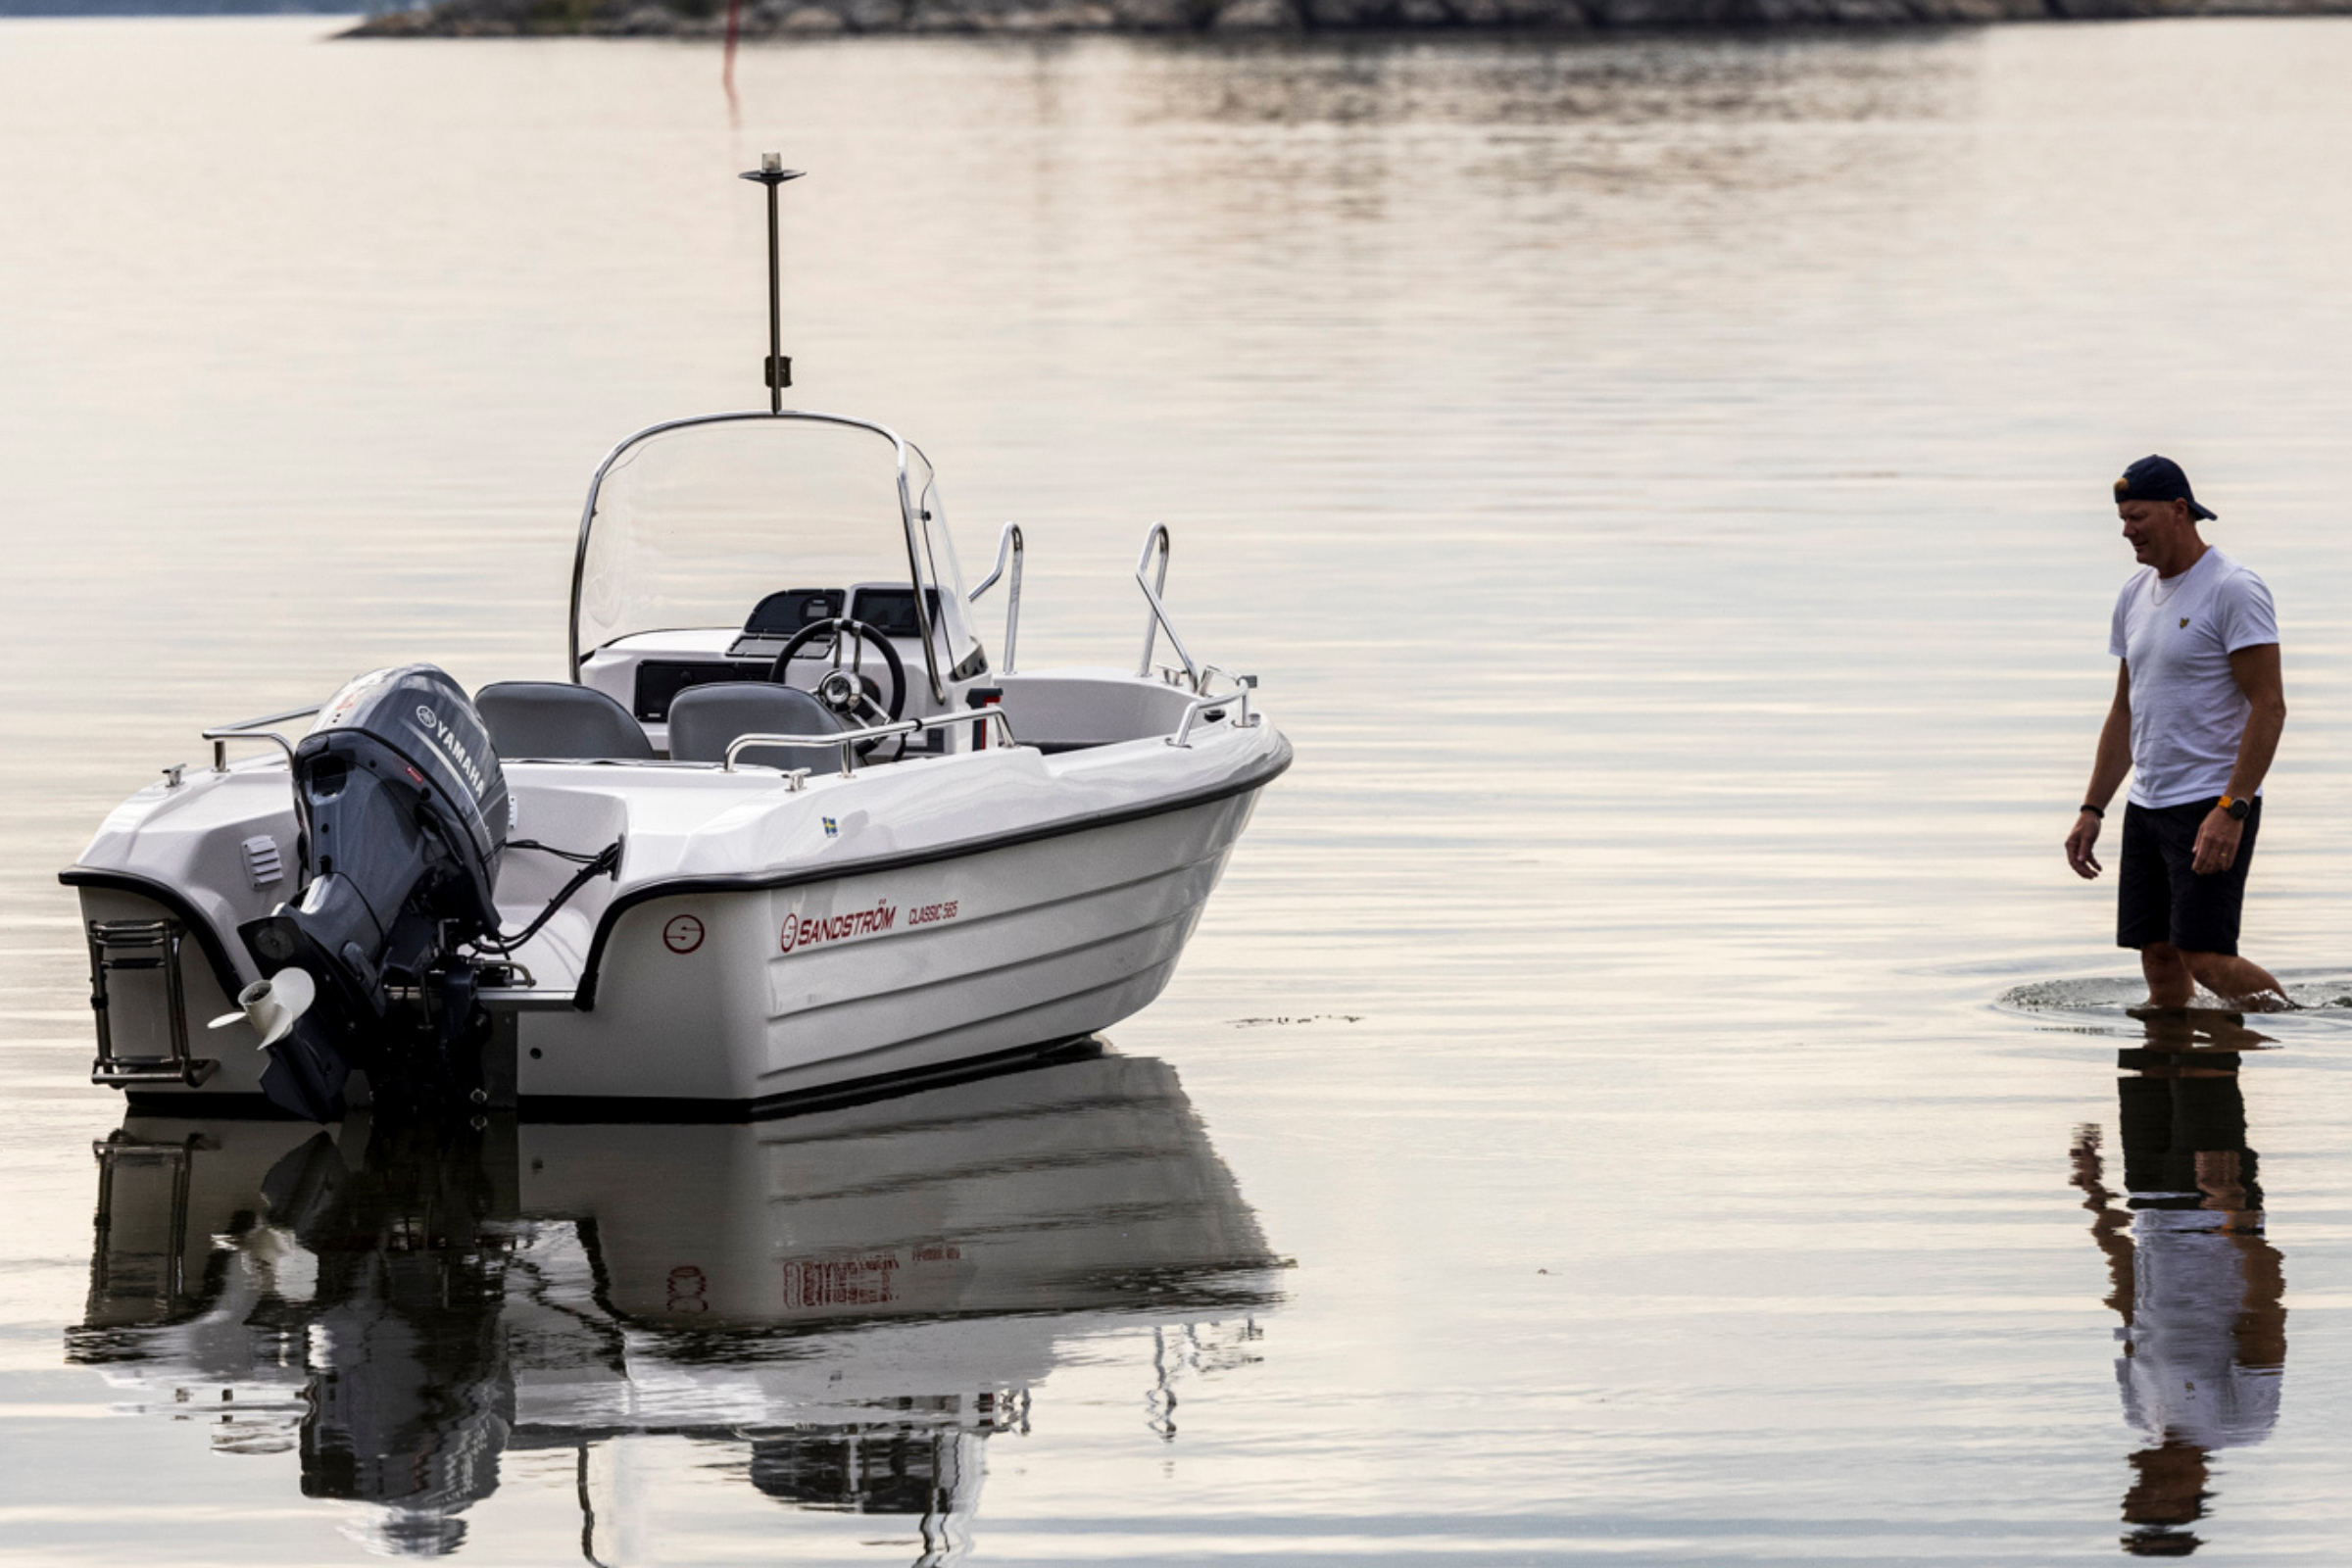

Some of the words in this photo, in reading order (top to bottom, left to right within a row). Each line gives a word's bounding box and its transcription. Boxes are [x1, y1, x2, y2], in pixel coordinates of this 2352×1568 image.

[437, 720, 484, 799] YAMAHA
[798, 899, 896, 946] SANDSTRÖM
[908, 904, 942, 925] CLASSIC
